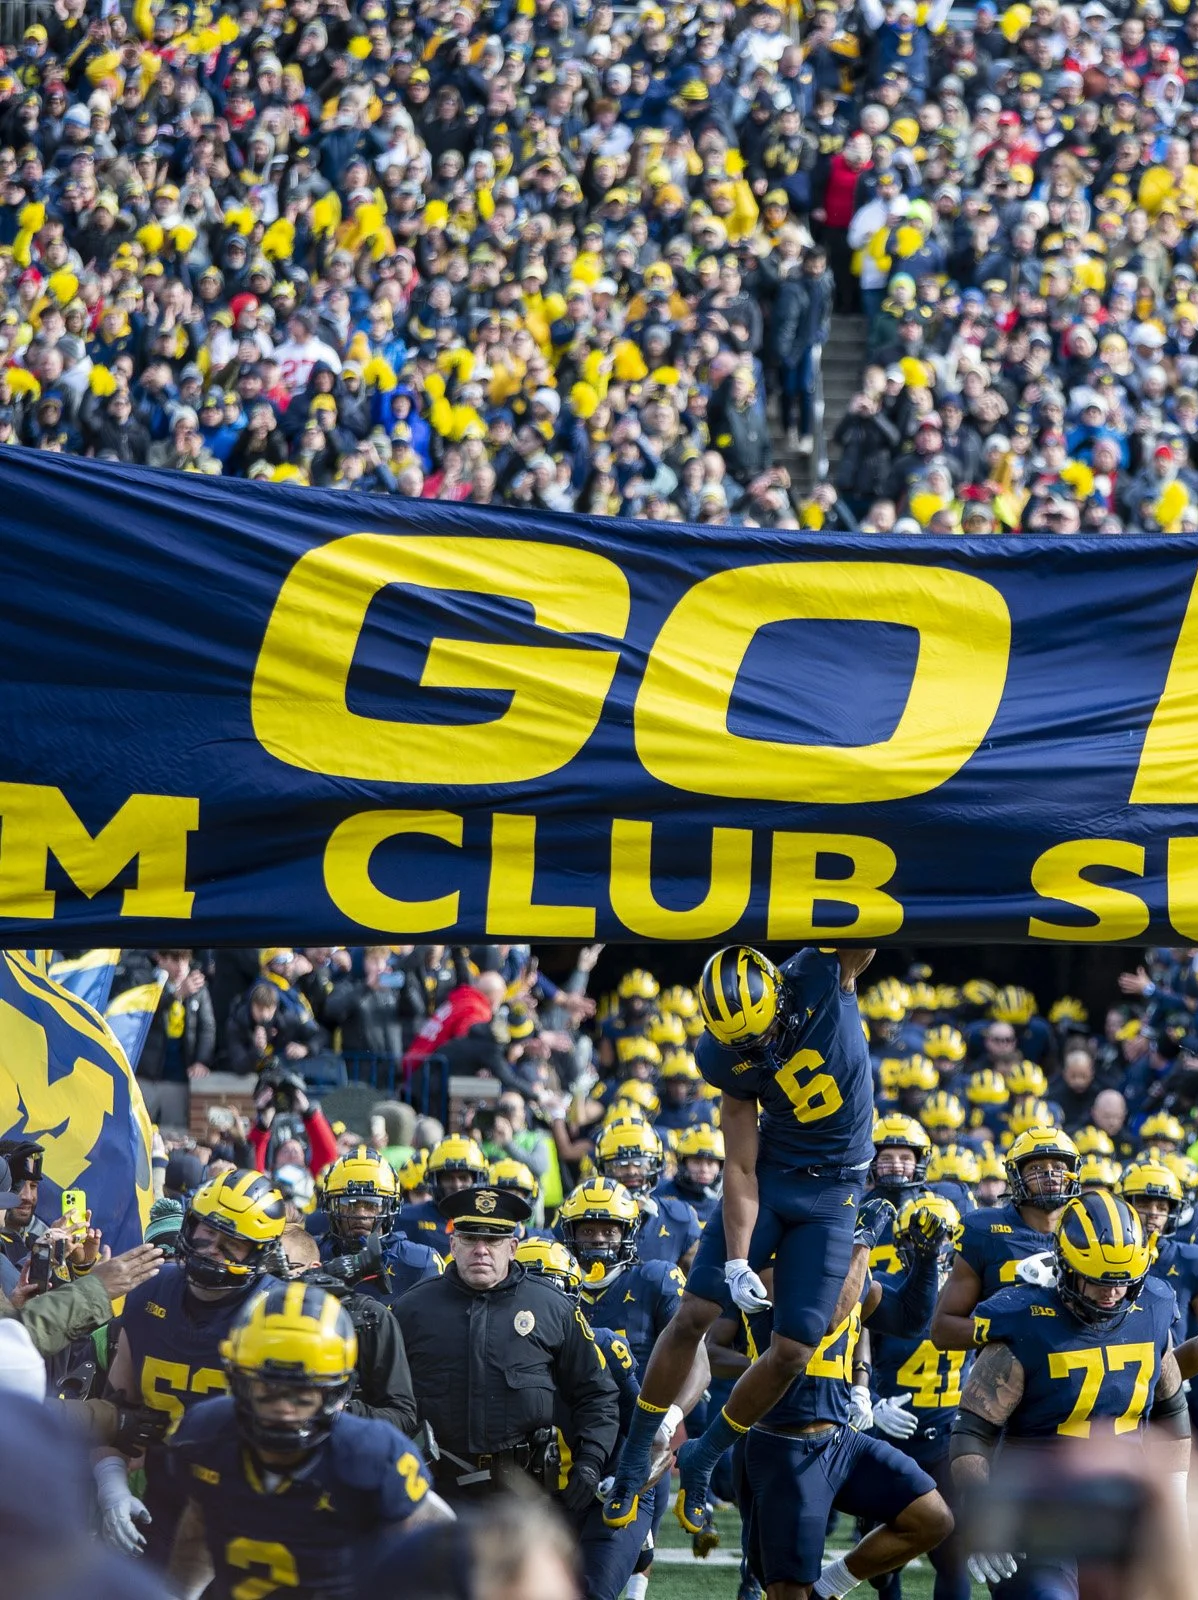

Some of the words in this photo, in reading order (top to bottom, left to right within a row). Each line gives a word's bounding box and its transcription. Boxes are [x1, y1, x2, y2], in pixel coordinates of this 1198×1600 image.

[251, 533, 1012, 803] GO
[0, 783, 199, 918] M
[323, 810, 904, 940] CLUB
[774, 1048, 843, 1123] 6
[611, 1340, 632, 1369] 9
[897, 1340, 965, 1407] 41
[1048, 1342, 1155, 1439] 77
